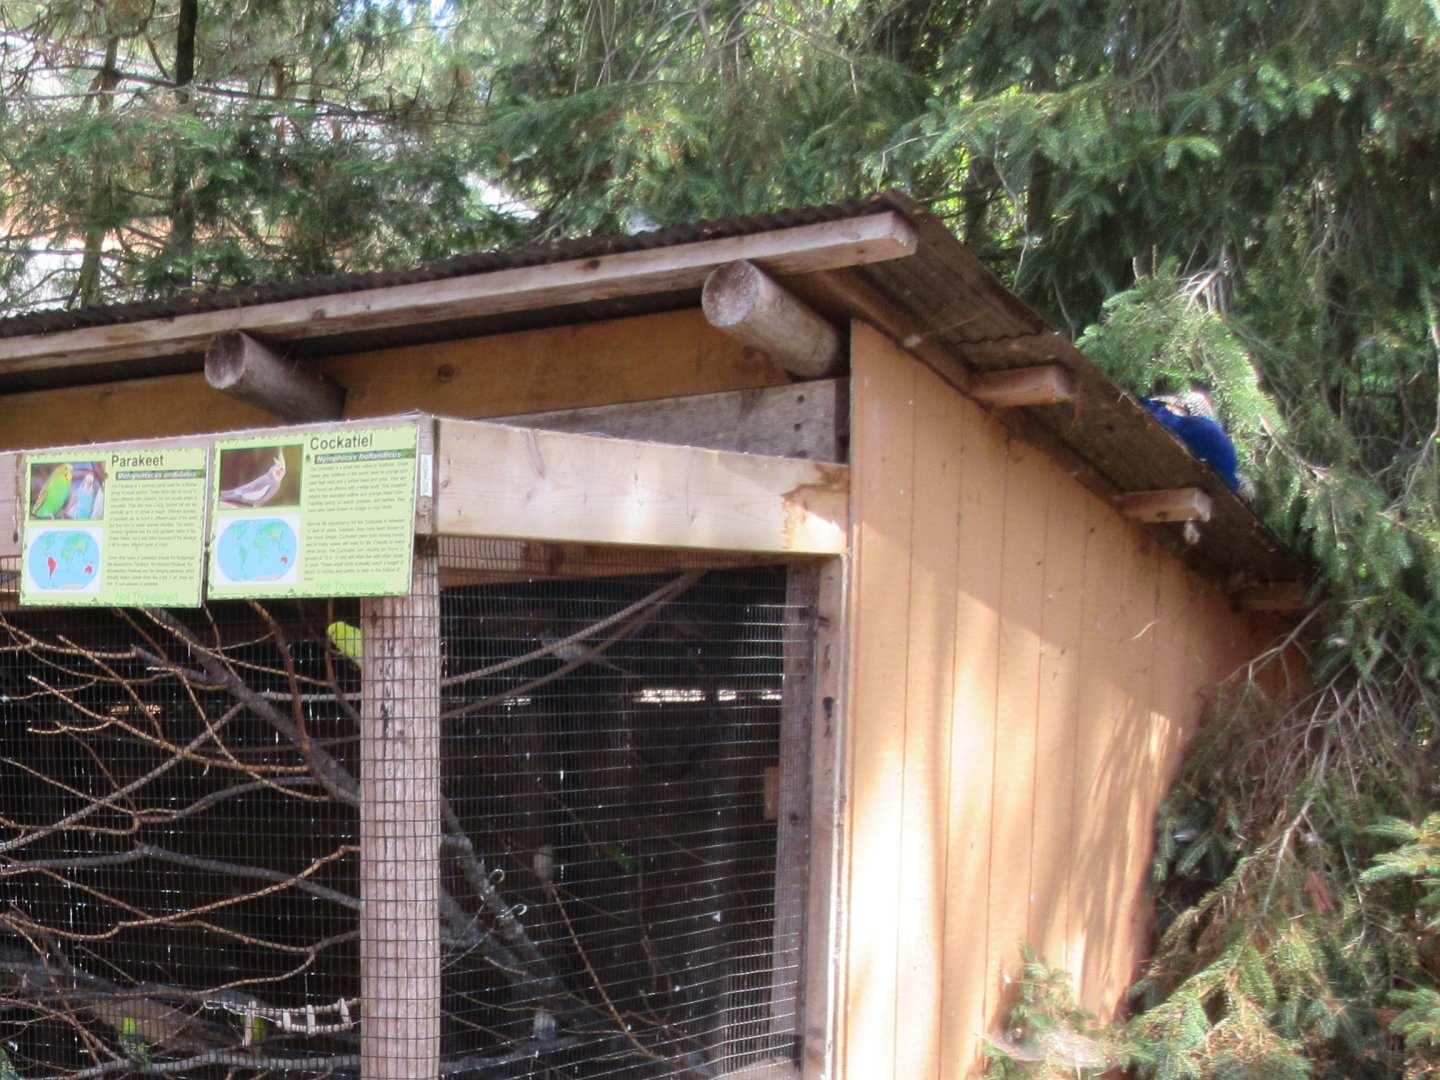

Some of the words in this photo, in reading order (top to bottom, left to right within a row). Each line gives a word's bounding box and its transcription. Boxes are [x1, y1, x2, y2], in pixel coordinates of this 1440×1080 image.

[310, 433, 373, 450] Cockatiel
[111, 454, 164, 468] Parakeet
[316, 582, 331, 591] Not
[335, 581, 386, 591] Threatened
[116, 593, 130, 602] Not
